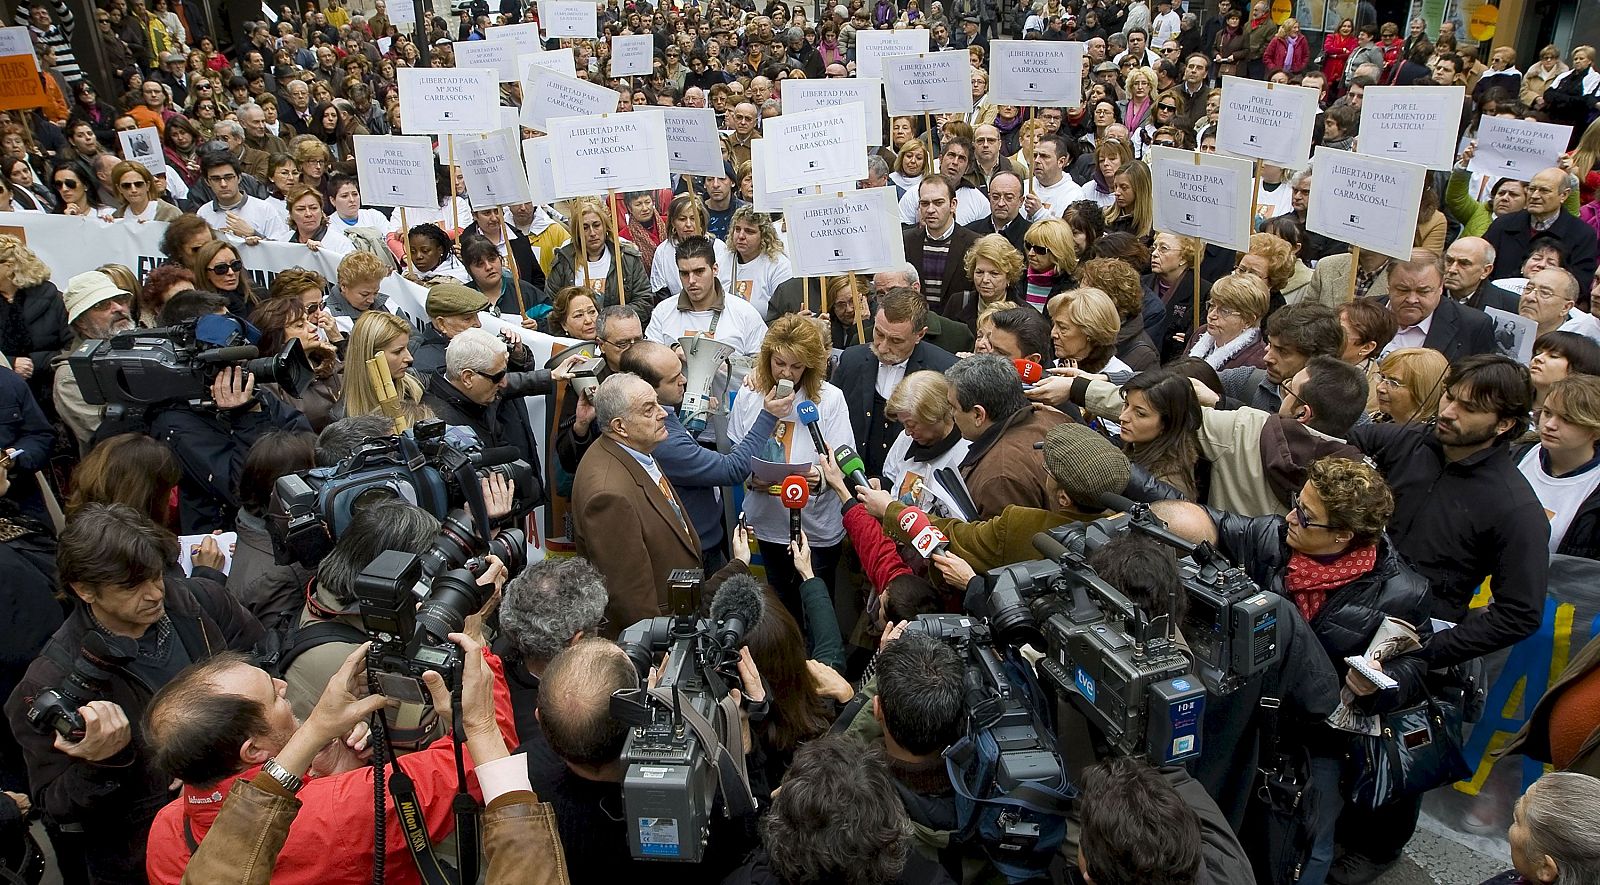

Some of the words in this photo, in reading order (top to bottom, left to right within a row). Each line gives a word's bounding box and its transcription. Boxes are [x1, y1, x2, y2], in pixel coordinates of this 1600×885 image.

[420, 77, 458, 85] ¡LIBERTAD
[547, 81, 581, 97] ¡LIBERTAD
[582, 93, 599, 102] PARA
[547, 96, 593, 115] CARRASCOSA!
[569, 96, 583, 105] JOSÉ
[1248, 96, 1264, 104] ¡POR
[1264, 98, 1274, 106] EL
[1230, 102, 1282, 117] CUMPLIMIENTO
[784, 120, 822, 135] ¡LIBERTAD
[824, 118, 844, 127] PARA
[1237, 113, 1247, 121] LA
[1248, 115, 1281, 127] JUSTICIA!
[569, 126, 613, 138] ¡LIBERTAD
[615, 124, 637, 132] PARA
[810, 130, 828, 138] JOSÉ
[1490, 125, 1532, 136] ¡LIBERTAD
[1533, 131, 1554, 140] PARA
[601, 135, 619, 144] JOSÉ
[789, 137, 841, 152] CARRASCOSA!
[1517, 137, 1535, 145] JOSÉ
[576, 145, 634, 157] CARRASCOSA!
[1491, 142, 1545, 156] CARRASCOSA!
[369, 158, 412, 167] CUMPLIMIENTO
[1167, 169, 1202, 181] ¡LIBERTAD
[1204, 175, 1224, 185] PARA
[1332, 165, 1373, 180] ¡LIBERTAD
[1374, 173, 1396, 185] PARA
[1189, 183, 1207, 192] JOSÉ
[1358, 182, 1377, 192] JOSÉ
[1170, 189, 1219, 205] CARRASCOSA!
[1334, 188, 1388, 207] CARRASCOSA!
[803, 207, 843, 220] ¡LIBERTAD
[844, 204, 869, 213] PARA
[832, 215, 851, 225] JOSÉ
[810, 225, 867, 238] CARRASCOSA!
[1024, 363, 1032, 378] rne
[801, 406, 814, 414] tve
[1077, 669, 1094, 697] tve
[401, 801, 417, 830] Nikon
